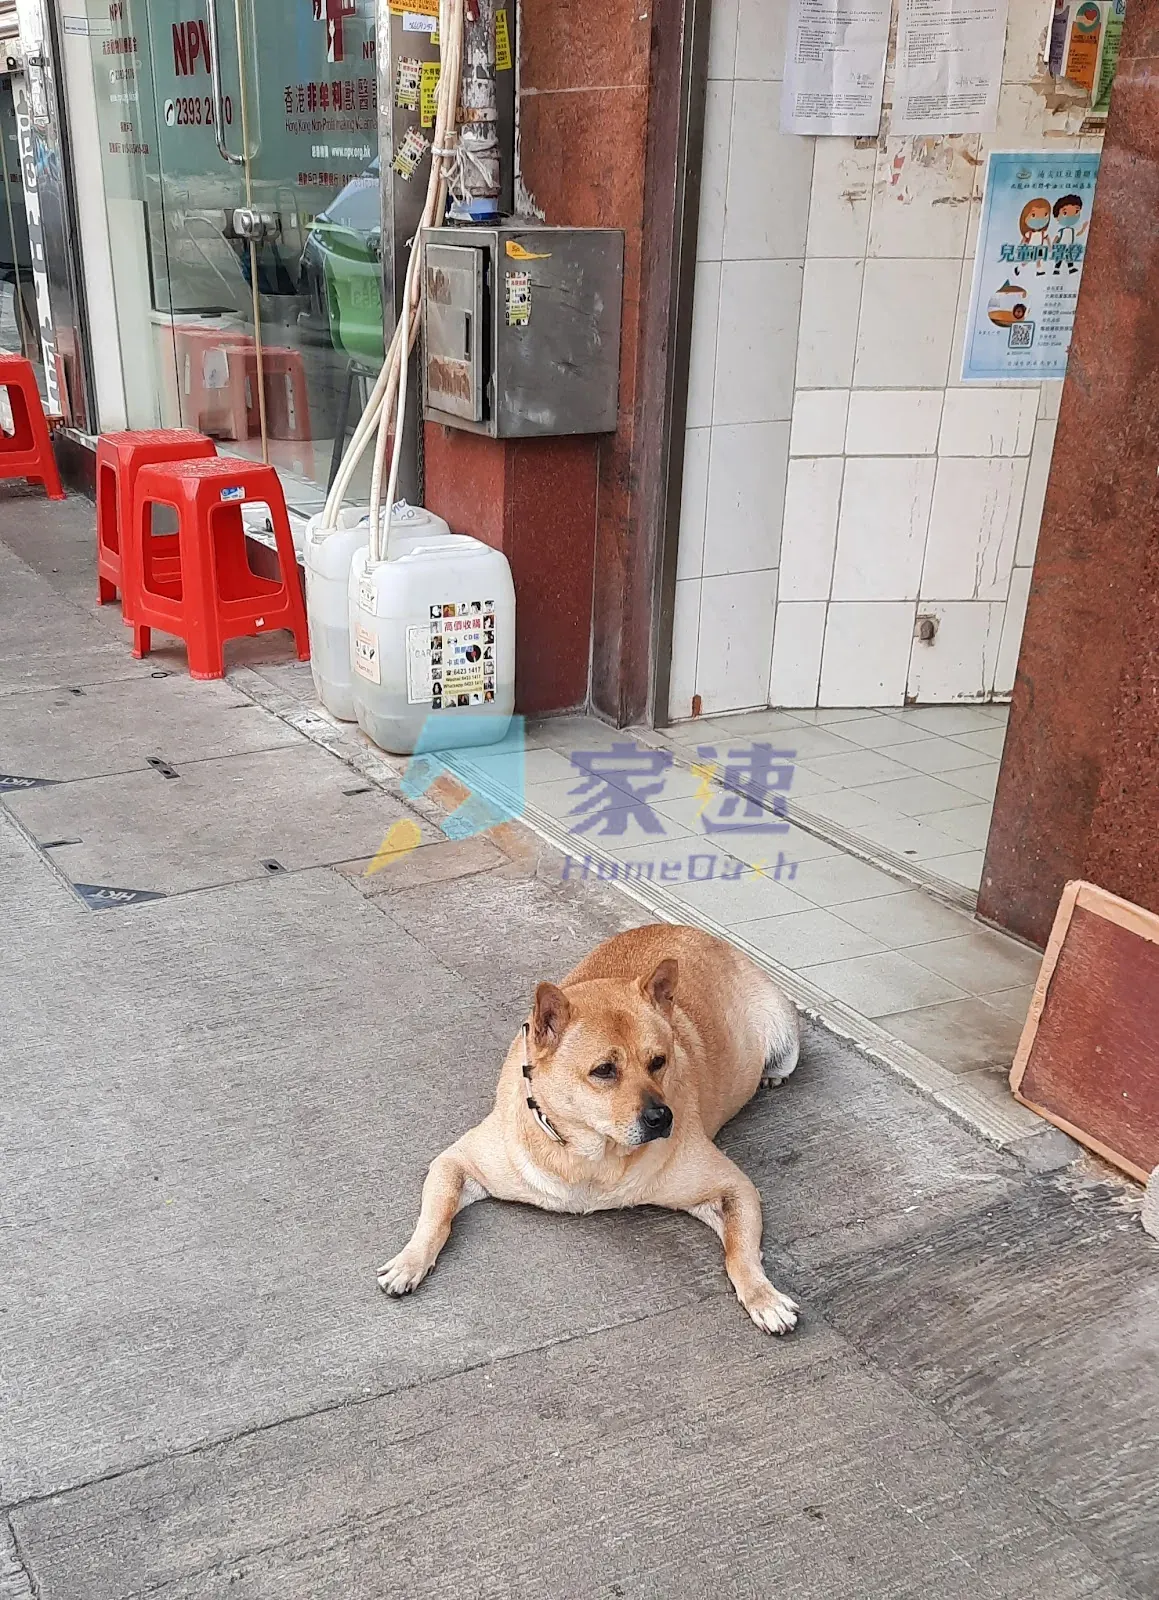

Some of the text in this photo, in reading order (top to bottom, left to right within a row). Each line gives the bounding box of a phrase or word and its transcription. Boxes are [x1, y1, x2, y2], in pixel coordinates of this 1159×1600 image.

[176, 95, 232, 125] 2393 20
[86, 889, 137, 901] HKT
